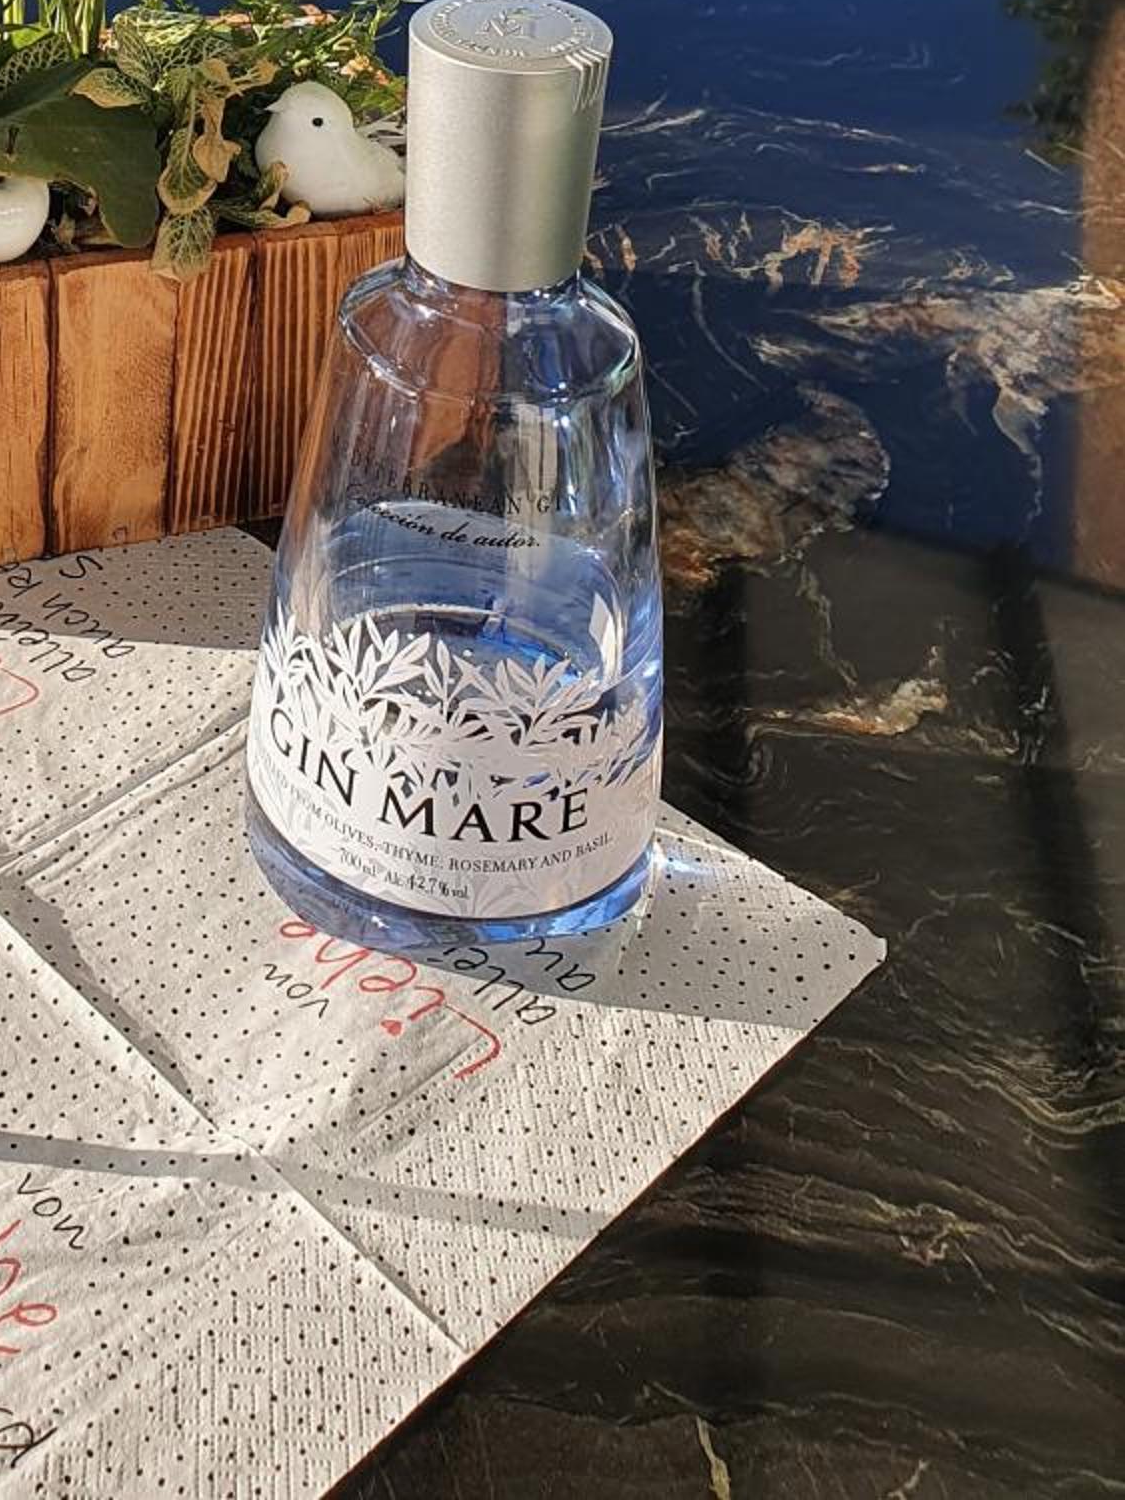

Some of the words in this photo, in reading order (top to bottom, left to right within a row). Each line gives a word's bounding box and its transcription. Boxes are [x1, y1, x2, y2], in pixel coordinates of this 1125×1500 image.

[440, 521, 468, 544] de
[43, 593, 136, 658] auch
[270, 707, 360, 807] GIN
[377, 784, 588, 843] MARE
[449, 856, 539, 873] ROSEMARY
[540, 849, 572, 868] AND
[576, 832, 613, 858] BASIL
[263, 963, 330, 1019] von
[18, 1172, 85, 1250] von
